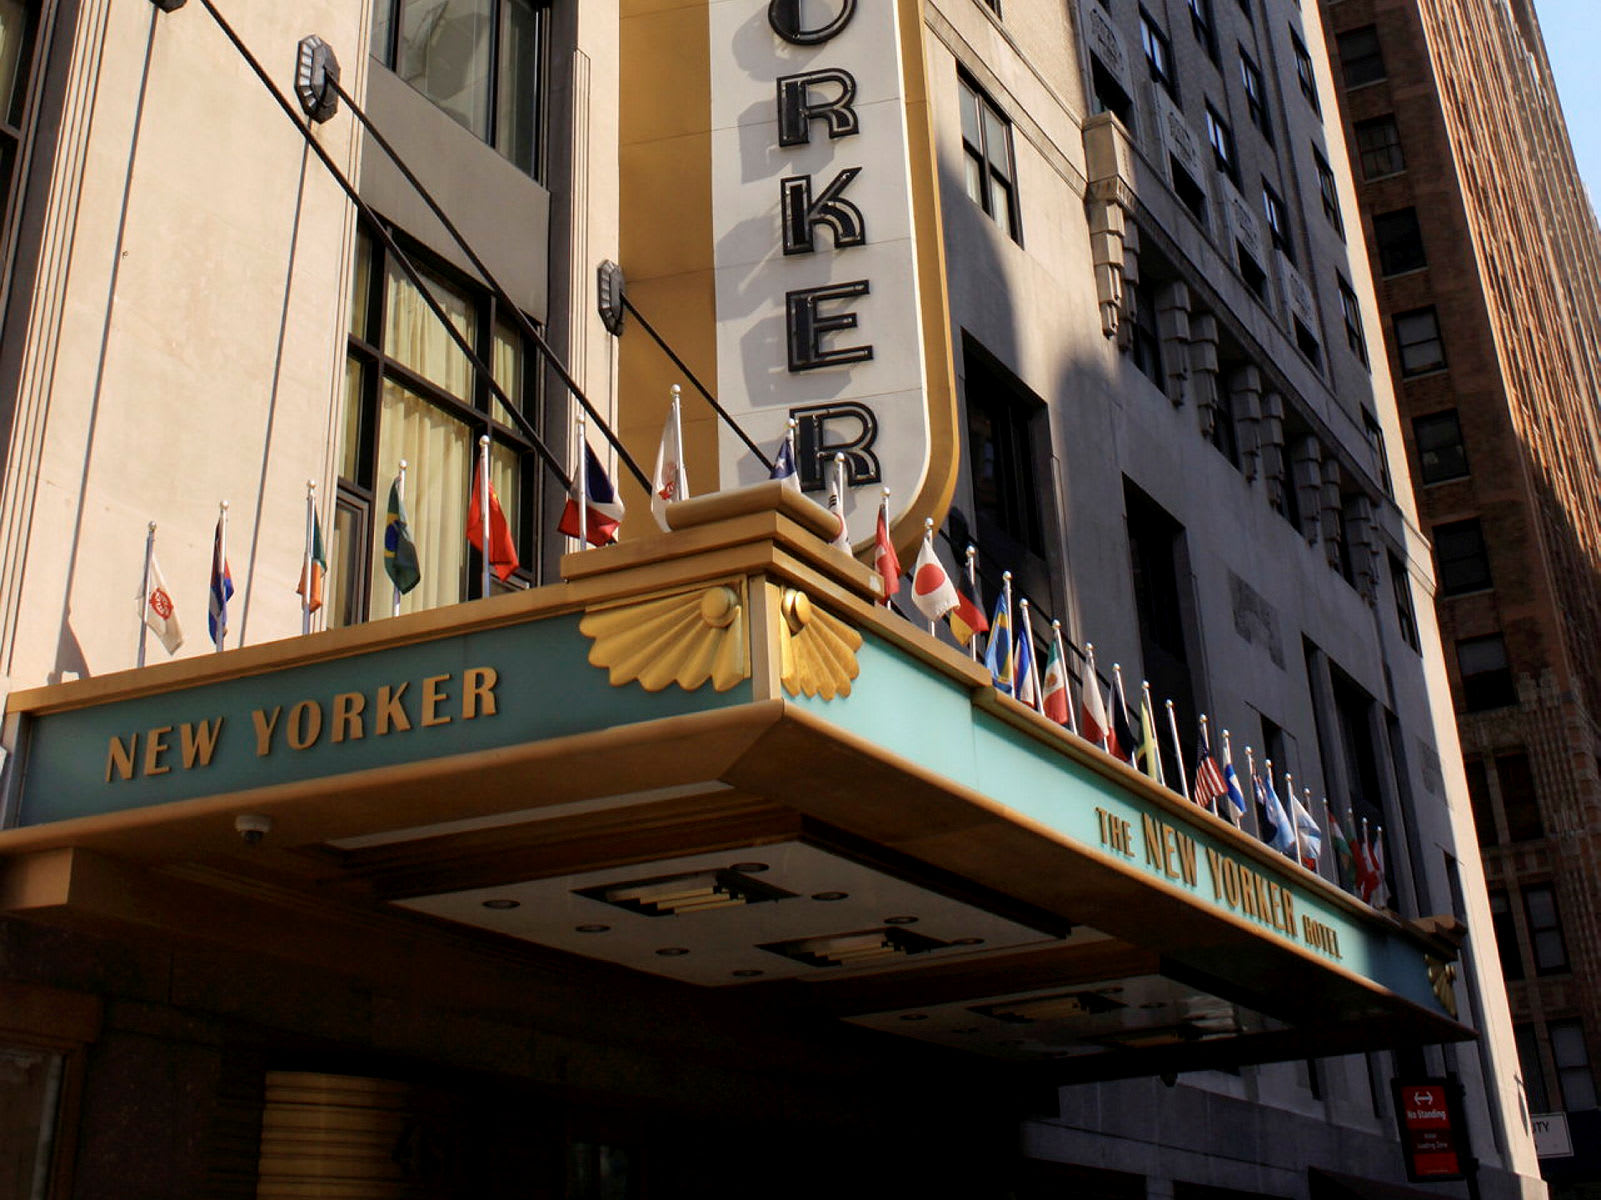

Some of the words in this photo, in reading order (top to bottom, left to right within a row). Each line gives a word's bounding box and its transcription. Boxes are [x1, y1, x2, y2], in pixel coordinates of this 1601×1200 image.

[105, 716, 224, 783] NEW
[251, 666, 499, 757] YORKER
[1095, 807, 1135, 858] THE
[1141, 812, 1198, 887] NEW
[1206, 846, 1298, 937] YORKER
[1302, 914, 1343, 959] HOTEL
[1407, 1109, 1417, 1120] No
[1417, 1108, 1447, 1121] Standing
[1532, 1121, 1550, 1133] TY
